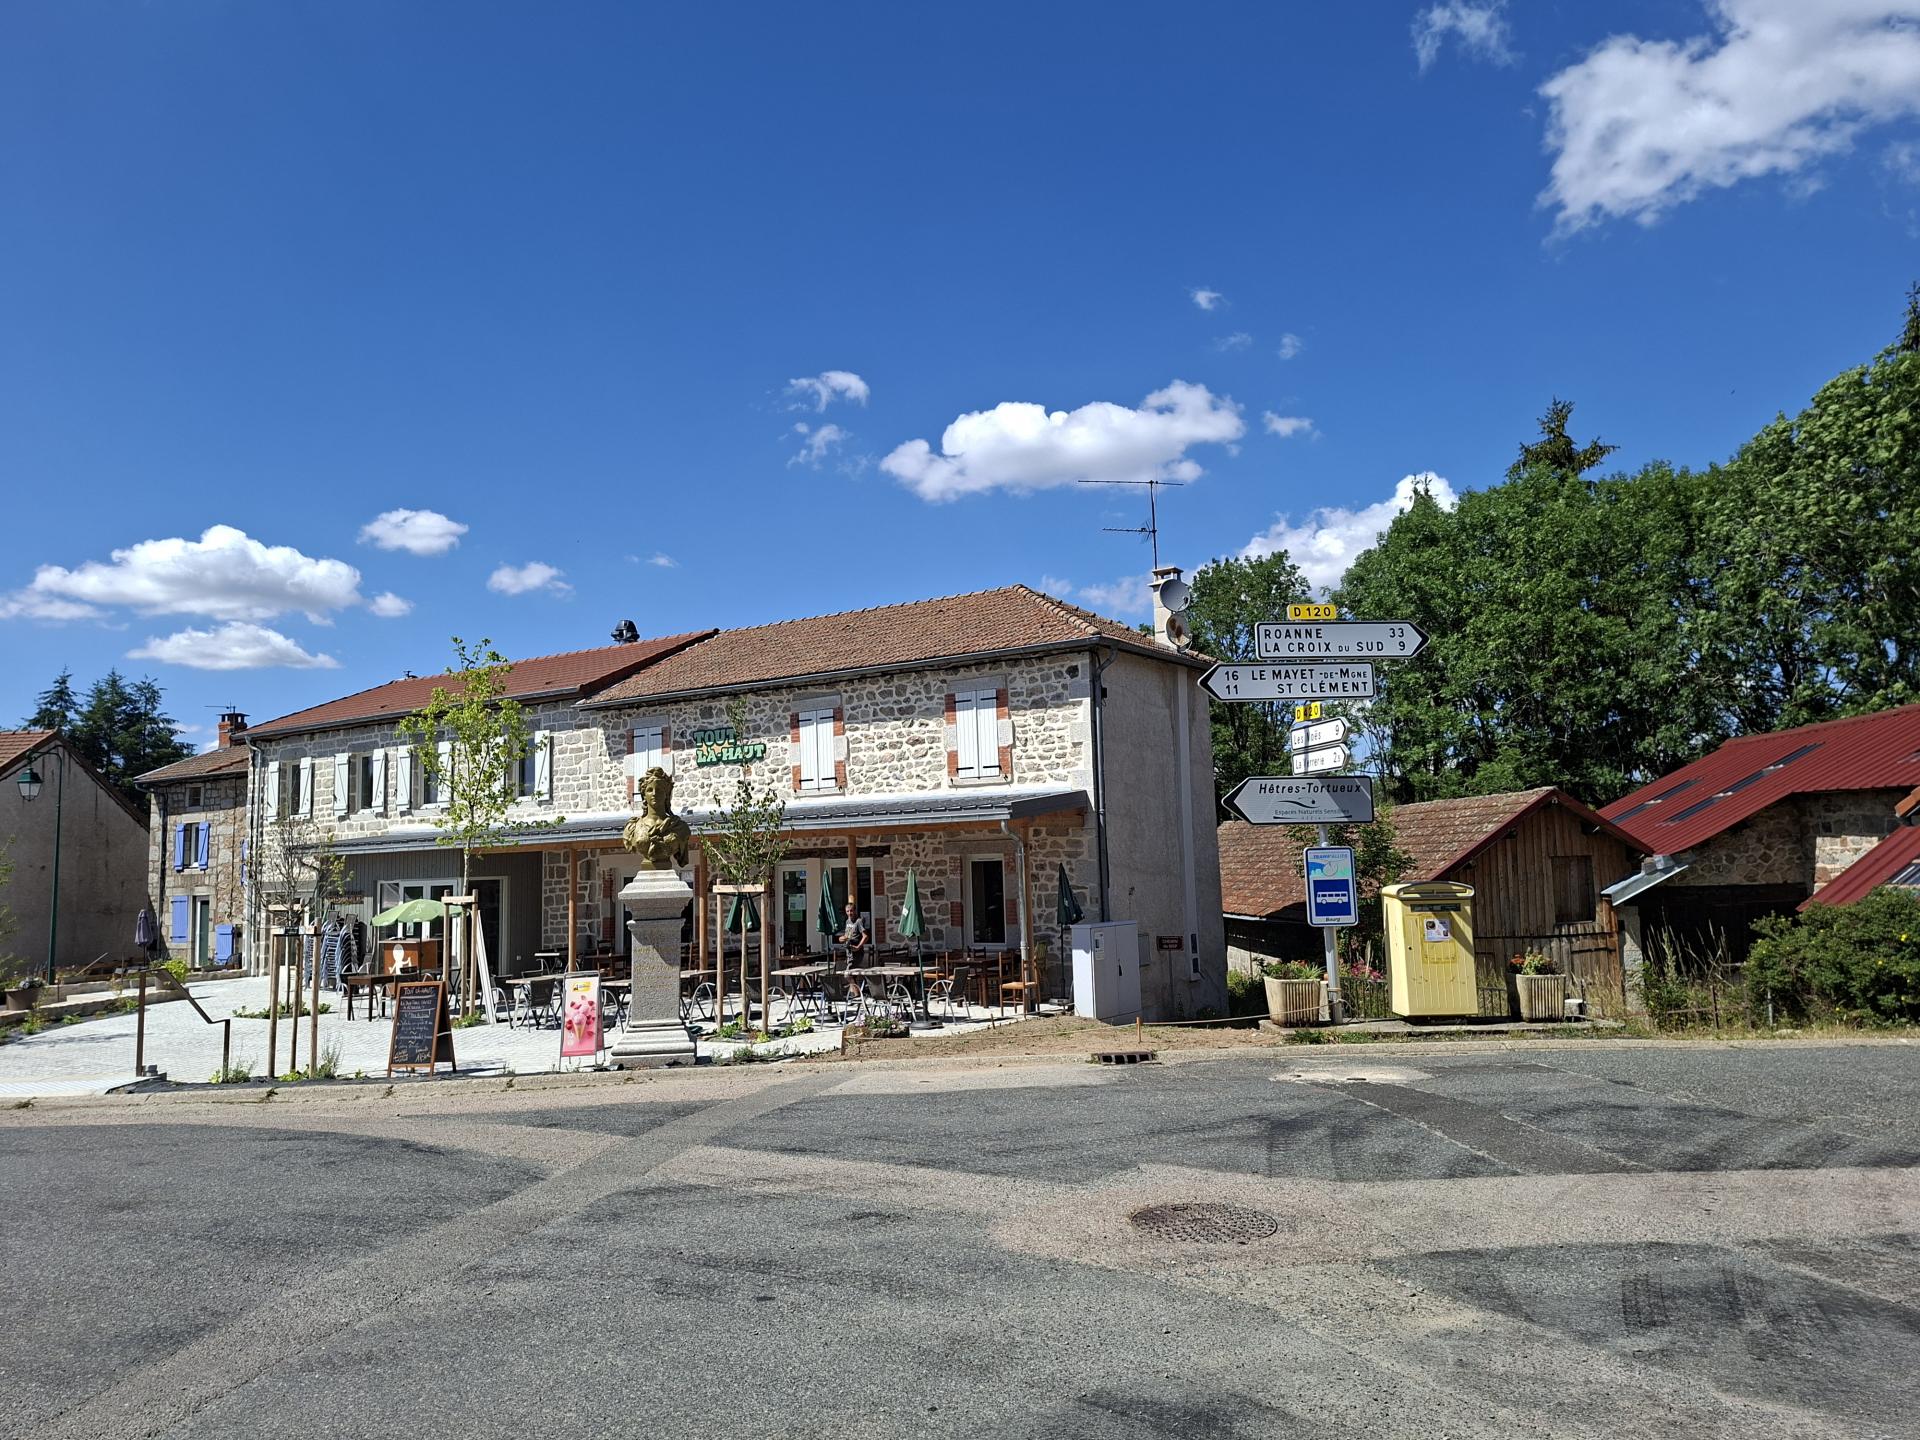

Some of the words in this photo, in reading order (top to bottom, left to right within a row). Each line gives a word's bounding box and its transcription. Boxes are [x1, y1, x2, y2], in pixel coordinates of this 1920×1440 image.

[1294, 607, 1301, 617] D
[1306, 607, 1331, 617] 120
[1264, 628, 1323, 639] ROANNE
[1389, 627, 1405, 638] 33
[1264, 643, 1281, 653] LA
[1287, 642, 1331, 653] CROIX
[1356, 641, 1384, 652] SUD
[1398, 641, 1406, 651] 9
[1224, 670, 1239, 681] 16
[1251, 670, 1267, 681] LE
[1272, 669, 1315, 680] MAYET
[1225, 685, 1239, 695] 11
[1278, 683, 1292, 694] ST
[1301, 680, 1368, 693] CLÉMENT
[1296, 709, 1302, 720] D
[1303, 705, 1319, 718] 420
[693, 728, 736, 746] TOUT
[1293, 733, 1304, 745] Les
[1335, 724, 1340, 736] 9
[1295, 759, 1302, 770] La
[1259, 782, 1361, 794] Hêtres-Tortueux
